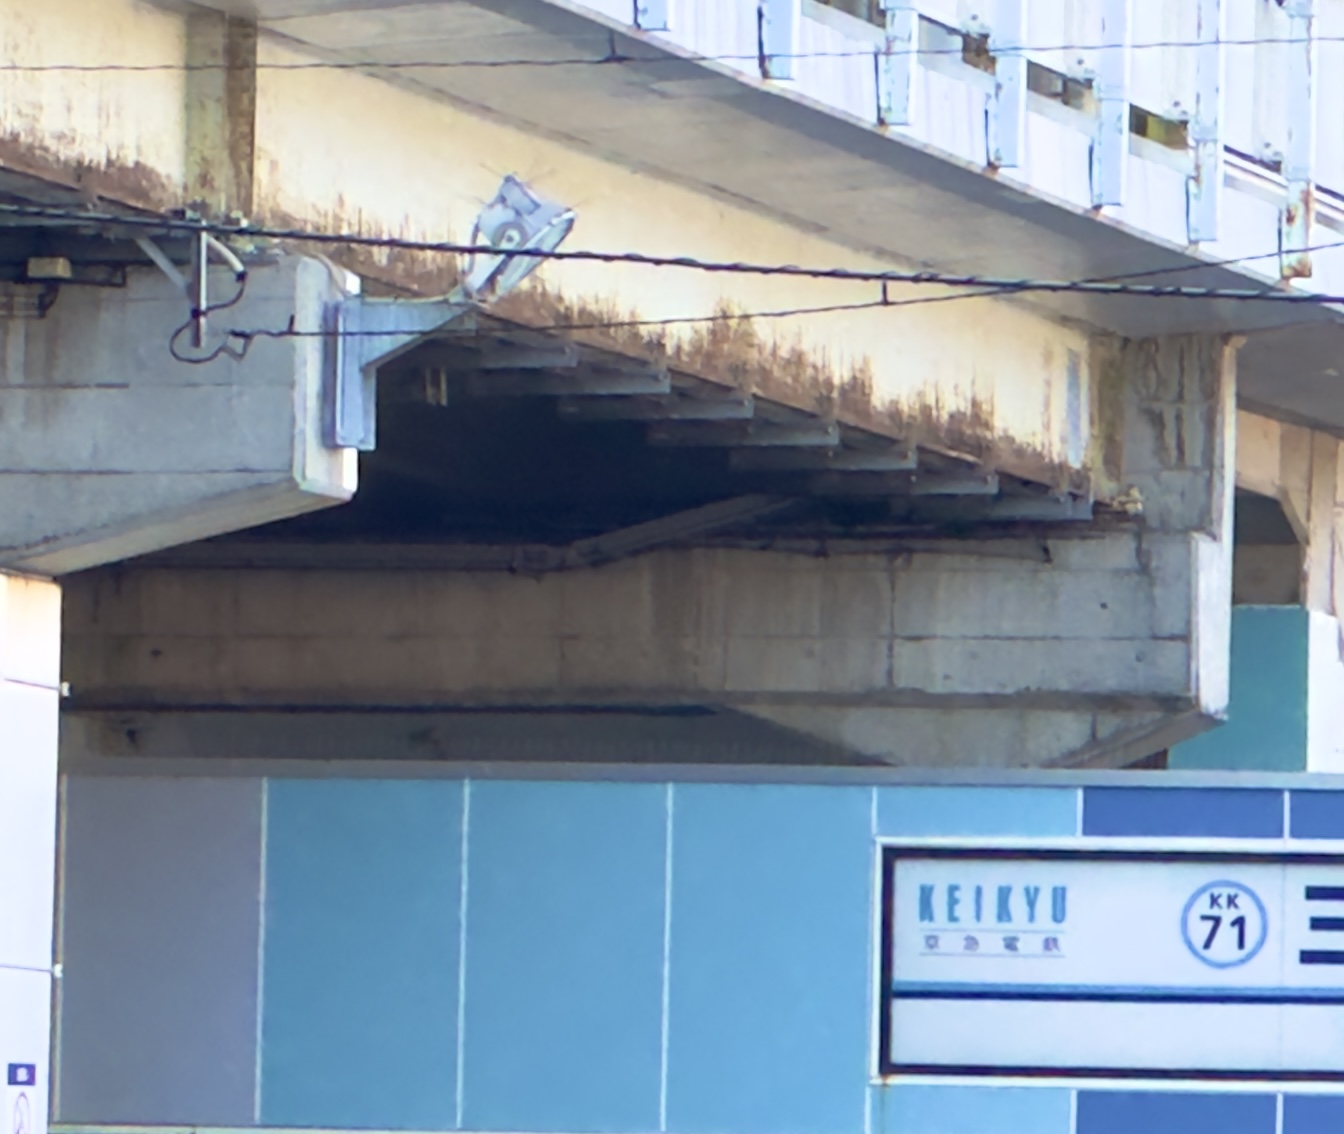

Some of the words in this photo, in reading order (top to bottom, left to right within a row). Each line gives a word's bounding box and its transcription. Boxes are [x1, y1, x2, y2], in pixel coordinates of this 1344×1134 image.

[918, 883, 1067, 924] KEIKYU
[1209, 892, 1239, 909] KK
[1200, 914, 1246, 950] 71
